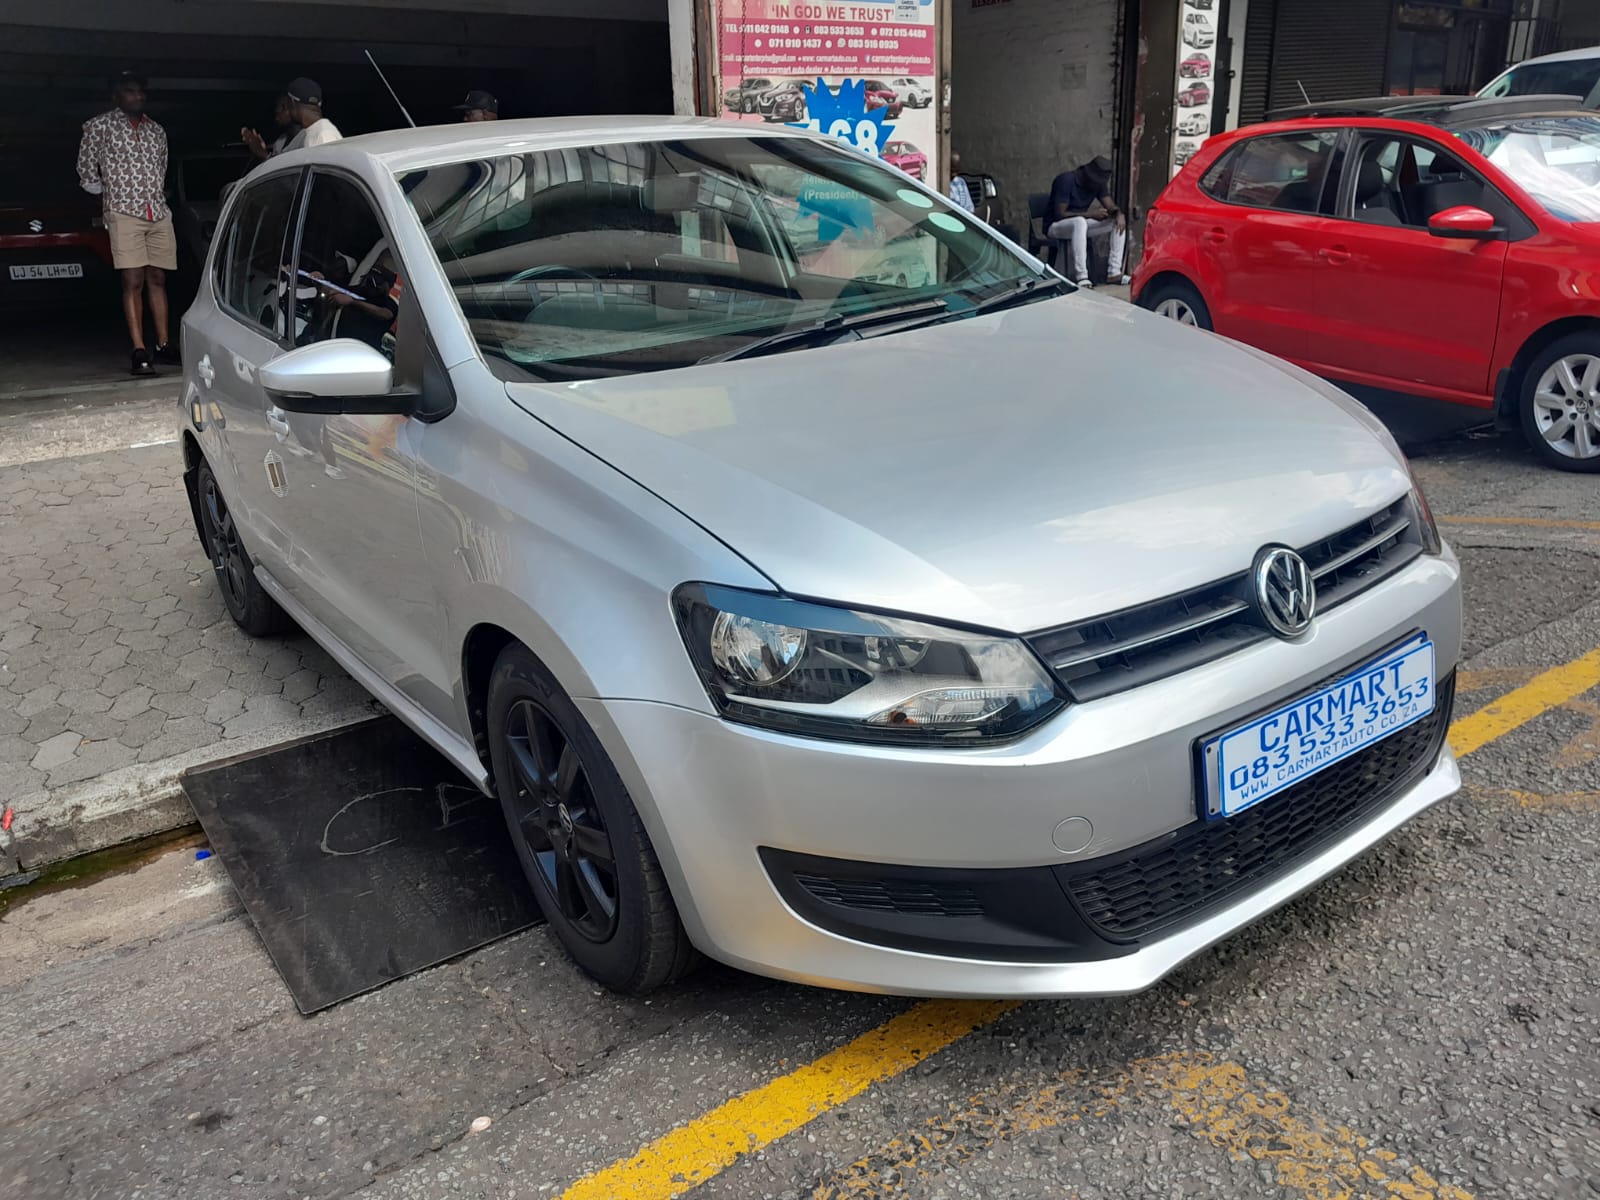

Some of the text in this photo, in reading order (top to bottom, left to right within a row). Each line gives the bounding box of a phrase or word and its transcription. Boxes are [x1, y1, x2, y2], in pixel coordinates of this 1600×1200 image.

[794, 5, 822, 18] GOD
[826, 6, 846, 20] WE
[725, 24, 738, 33] TEL
[768, 38, 784, 48] 071
[12, 265, 80, 278] LJ 54 LH GP
[1260, 660, 1405, 752] CARMART
[1230, 676, 1429, 791] 083 533 3653
